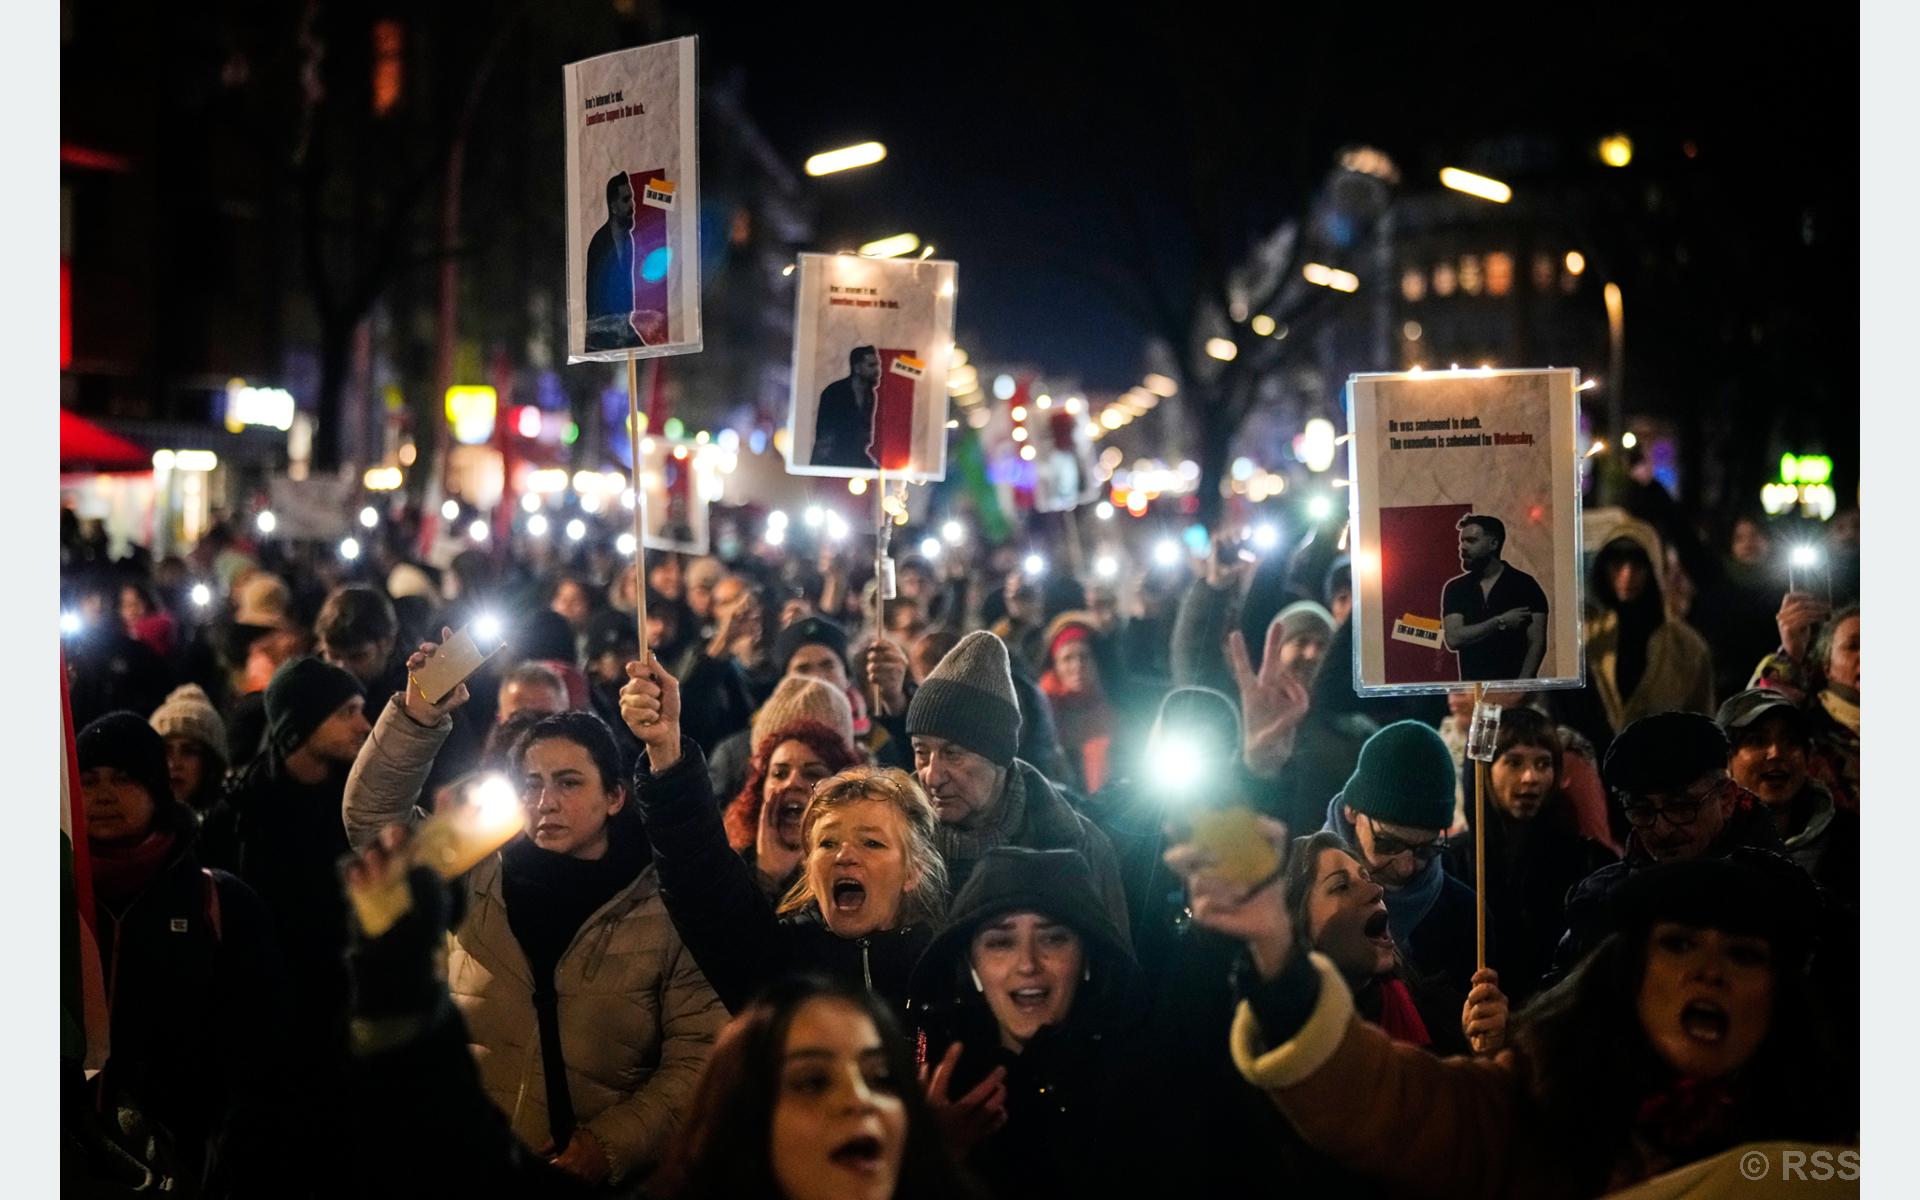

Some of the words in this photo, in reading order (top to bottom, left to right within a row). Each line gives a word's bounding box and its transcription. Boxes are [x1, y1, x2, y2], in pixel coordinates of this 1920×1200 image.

[1389, 420, 1398, 432] He
[1400, 421, 1413, 432] was
[1415, 418, 1450, 432] sentenced
[1452, 418, 1459, 430] to
[1460, 416, 1482, 429] death.
[1390, 437, 1402, 450] The
[1403, 436, 1437, 449] execution
[1438, 435, 1445, 448] is
[1446, 434, 1480, 447] scheduled
[1482, 433, 1492, 446] for
[1493, 432, 1536, 447] Wednesday.
